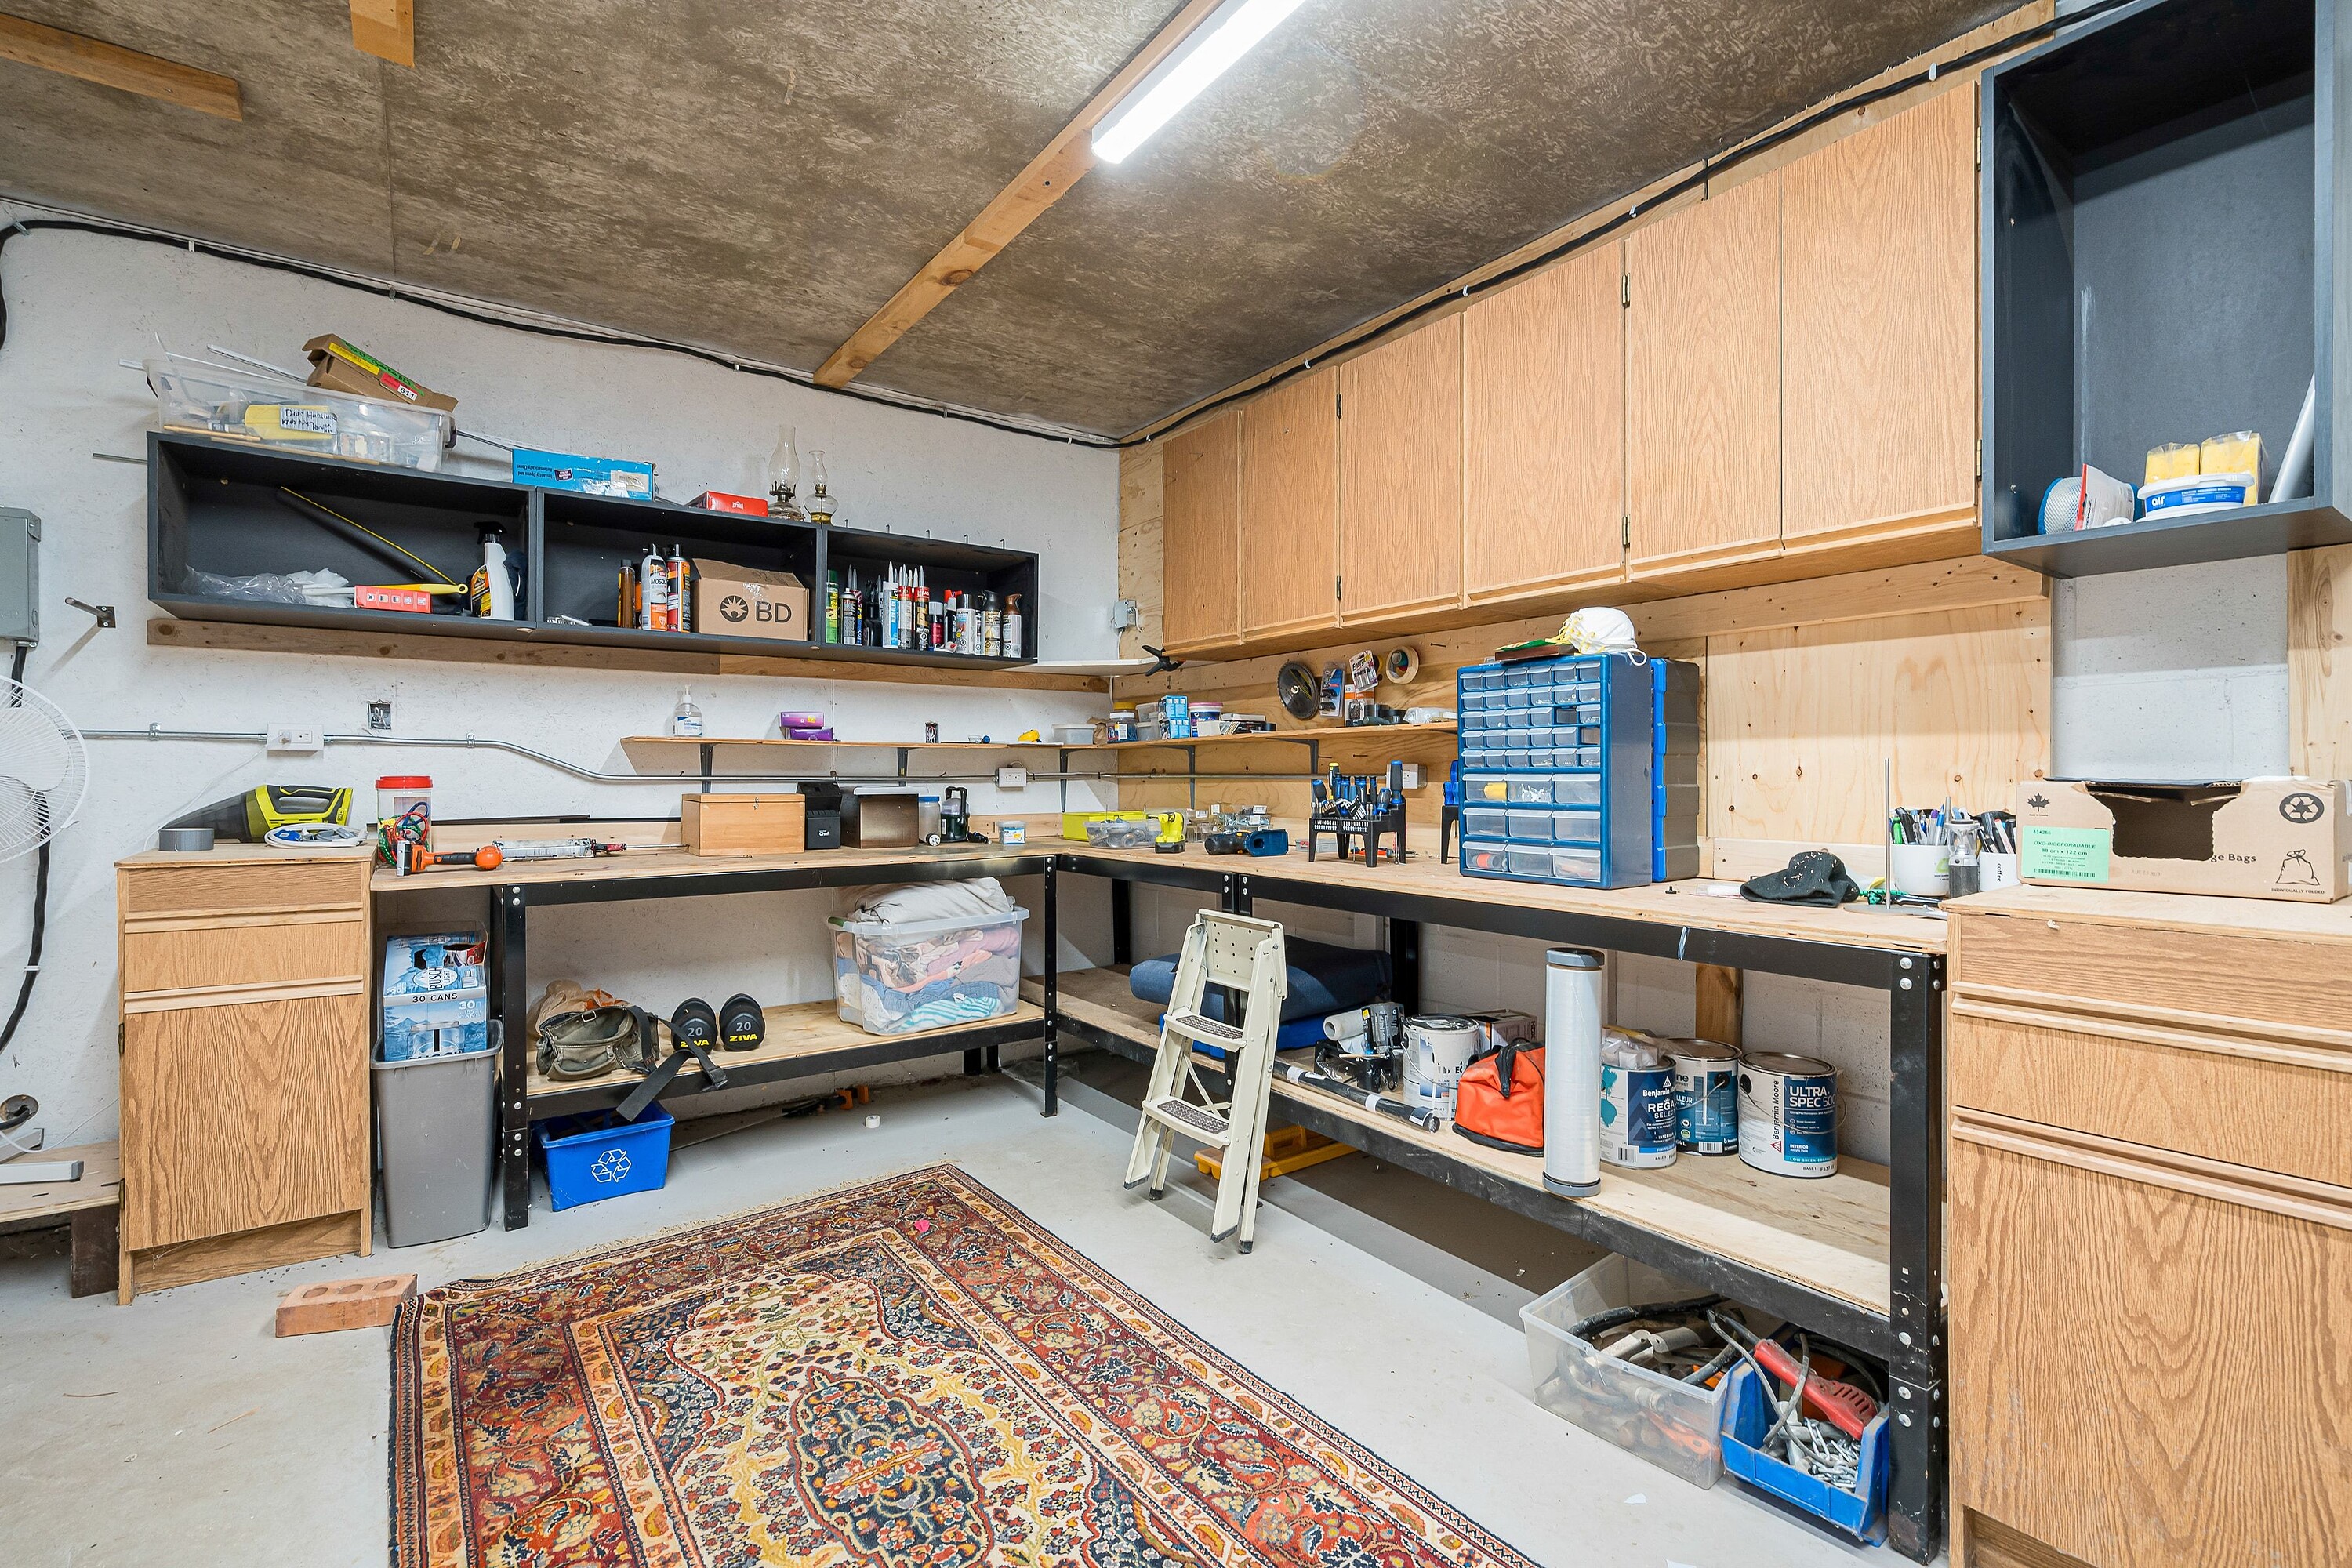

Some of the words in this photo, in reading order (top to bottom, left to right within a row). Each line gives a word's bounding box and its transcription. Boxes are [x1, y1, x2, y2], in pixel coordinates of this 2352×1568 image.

[400, 387, 415, 399] 611
[756, 601, 792, 623] BD
[2228, 853, 2256, 864] Bags
[428, 966, 443, 989] BUSCH
[430, 993, 458, 1002] CANS
[459, 1000, 476, 1010] 30
[687, 1027, 703, 1037] 20
[737, 1022, 752, 1032] 20
[729, 1033, 758, 1042] ZIVA
[1642, 1088, 1671, 1098] Benjamin
[1789, 1086, 1828, 1097] ULTRA
[1789, 1097, 1821, 1108] SPEC
[1772, 1106, 1781, 1140] Benjamin
